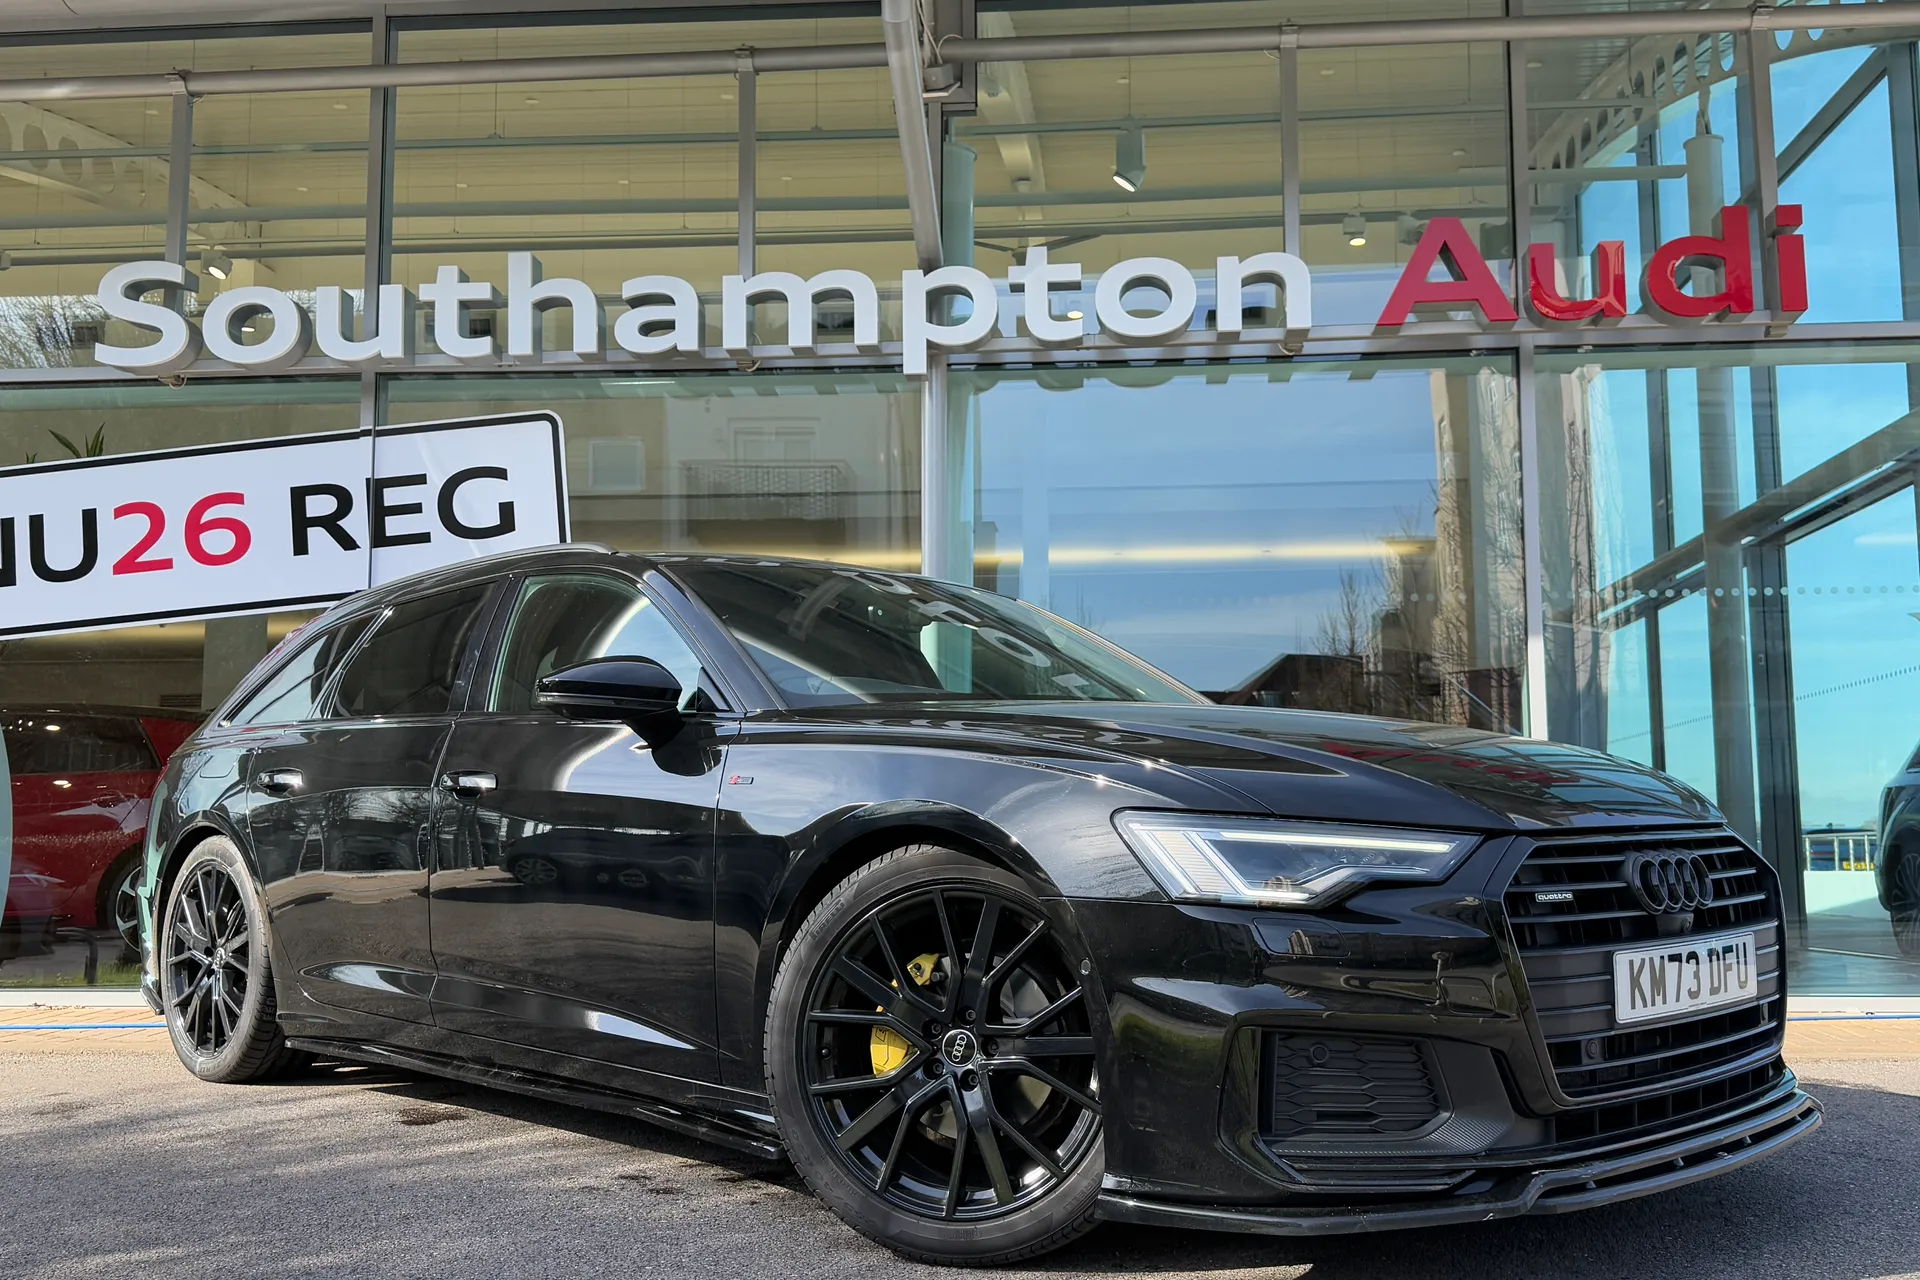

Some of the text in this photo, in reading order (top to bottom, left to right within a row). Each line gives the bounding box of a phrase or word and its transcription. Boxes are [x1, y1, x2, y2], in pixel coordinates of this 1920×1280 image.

[95, 204, 1809, 377] Southampton Audi
[0, 466, 516, 588] U26 REG
[1538, 893, 1573, 901] quattro
[1628, 942, 1748, 1010] KM73 DFU
